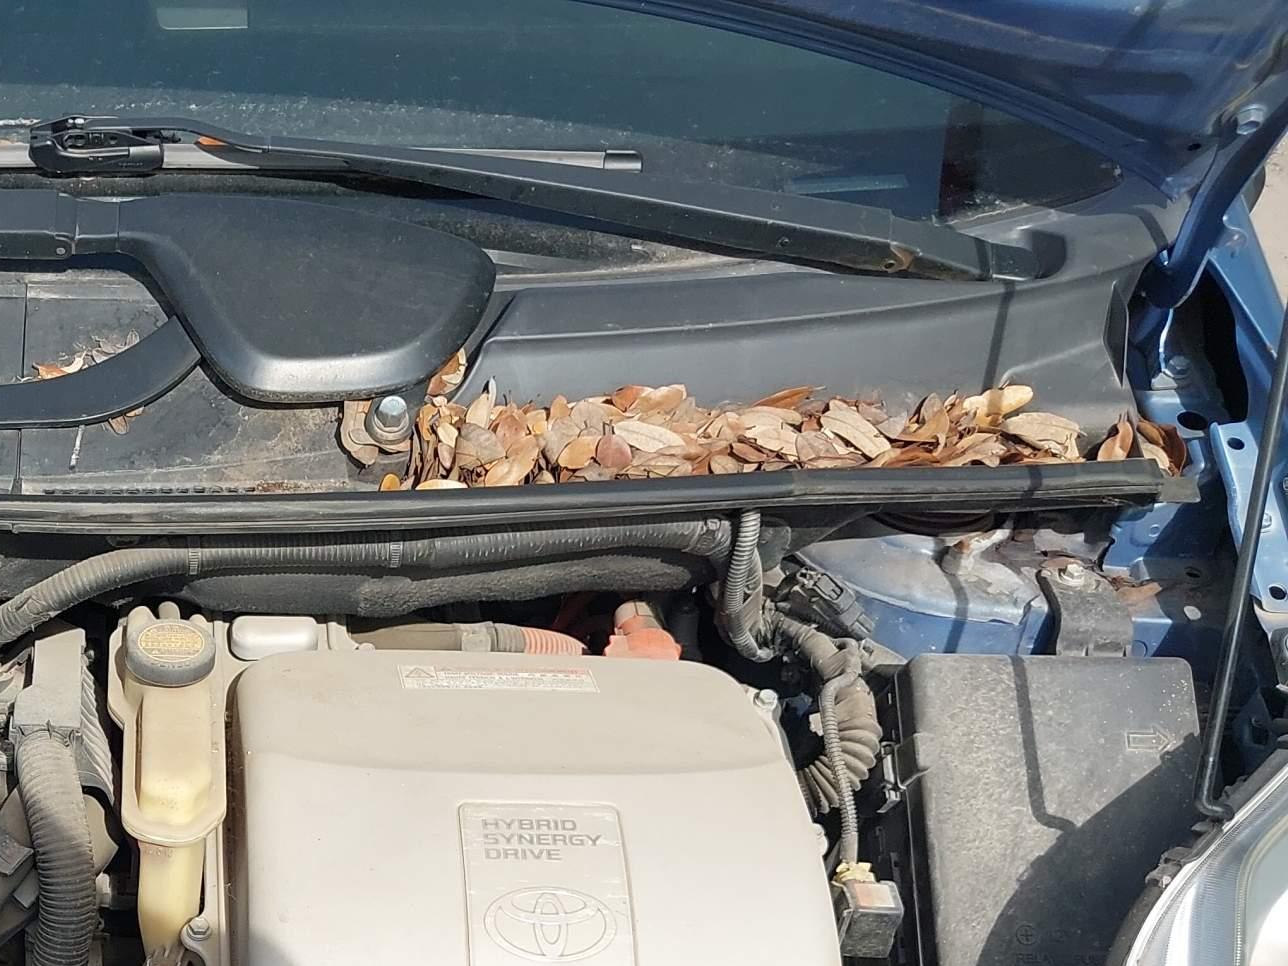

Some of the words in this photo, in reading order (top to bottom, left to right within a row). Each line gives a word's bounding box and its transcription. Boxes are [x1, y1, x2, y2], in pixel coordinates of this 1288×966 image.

[482, 818, 577, 832] HYBRID
[483, 833, 602, 847] SYNERGY
[485, 848, 561, 861] DRIVE
